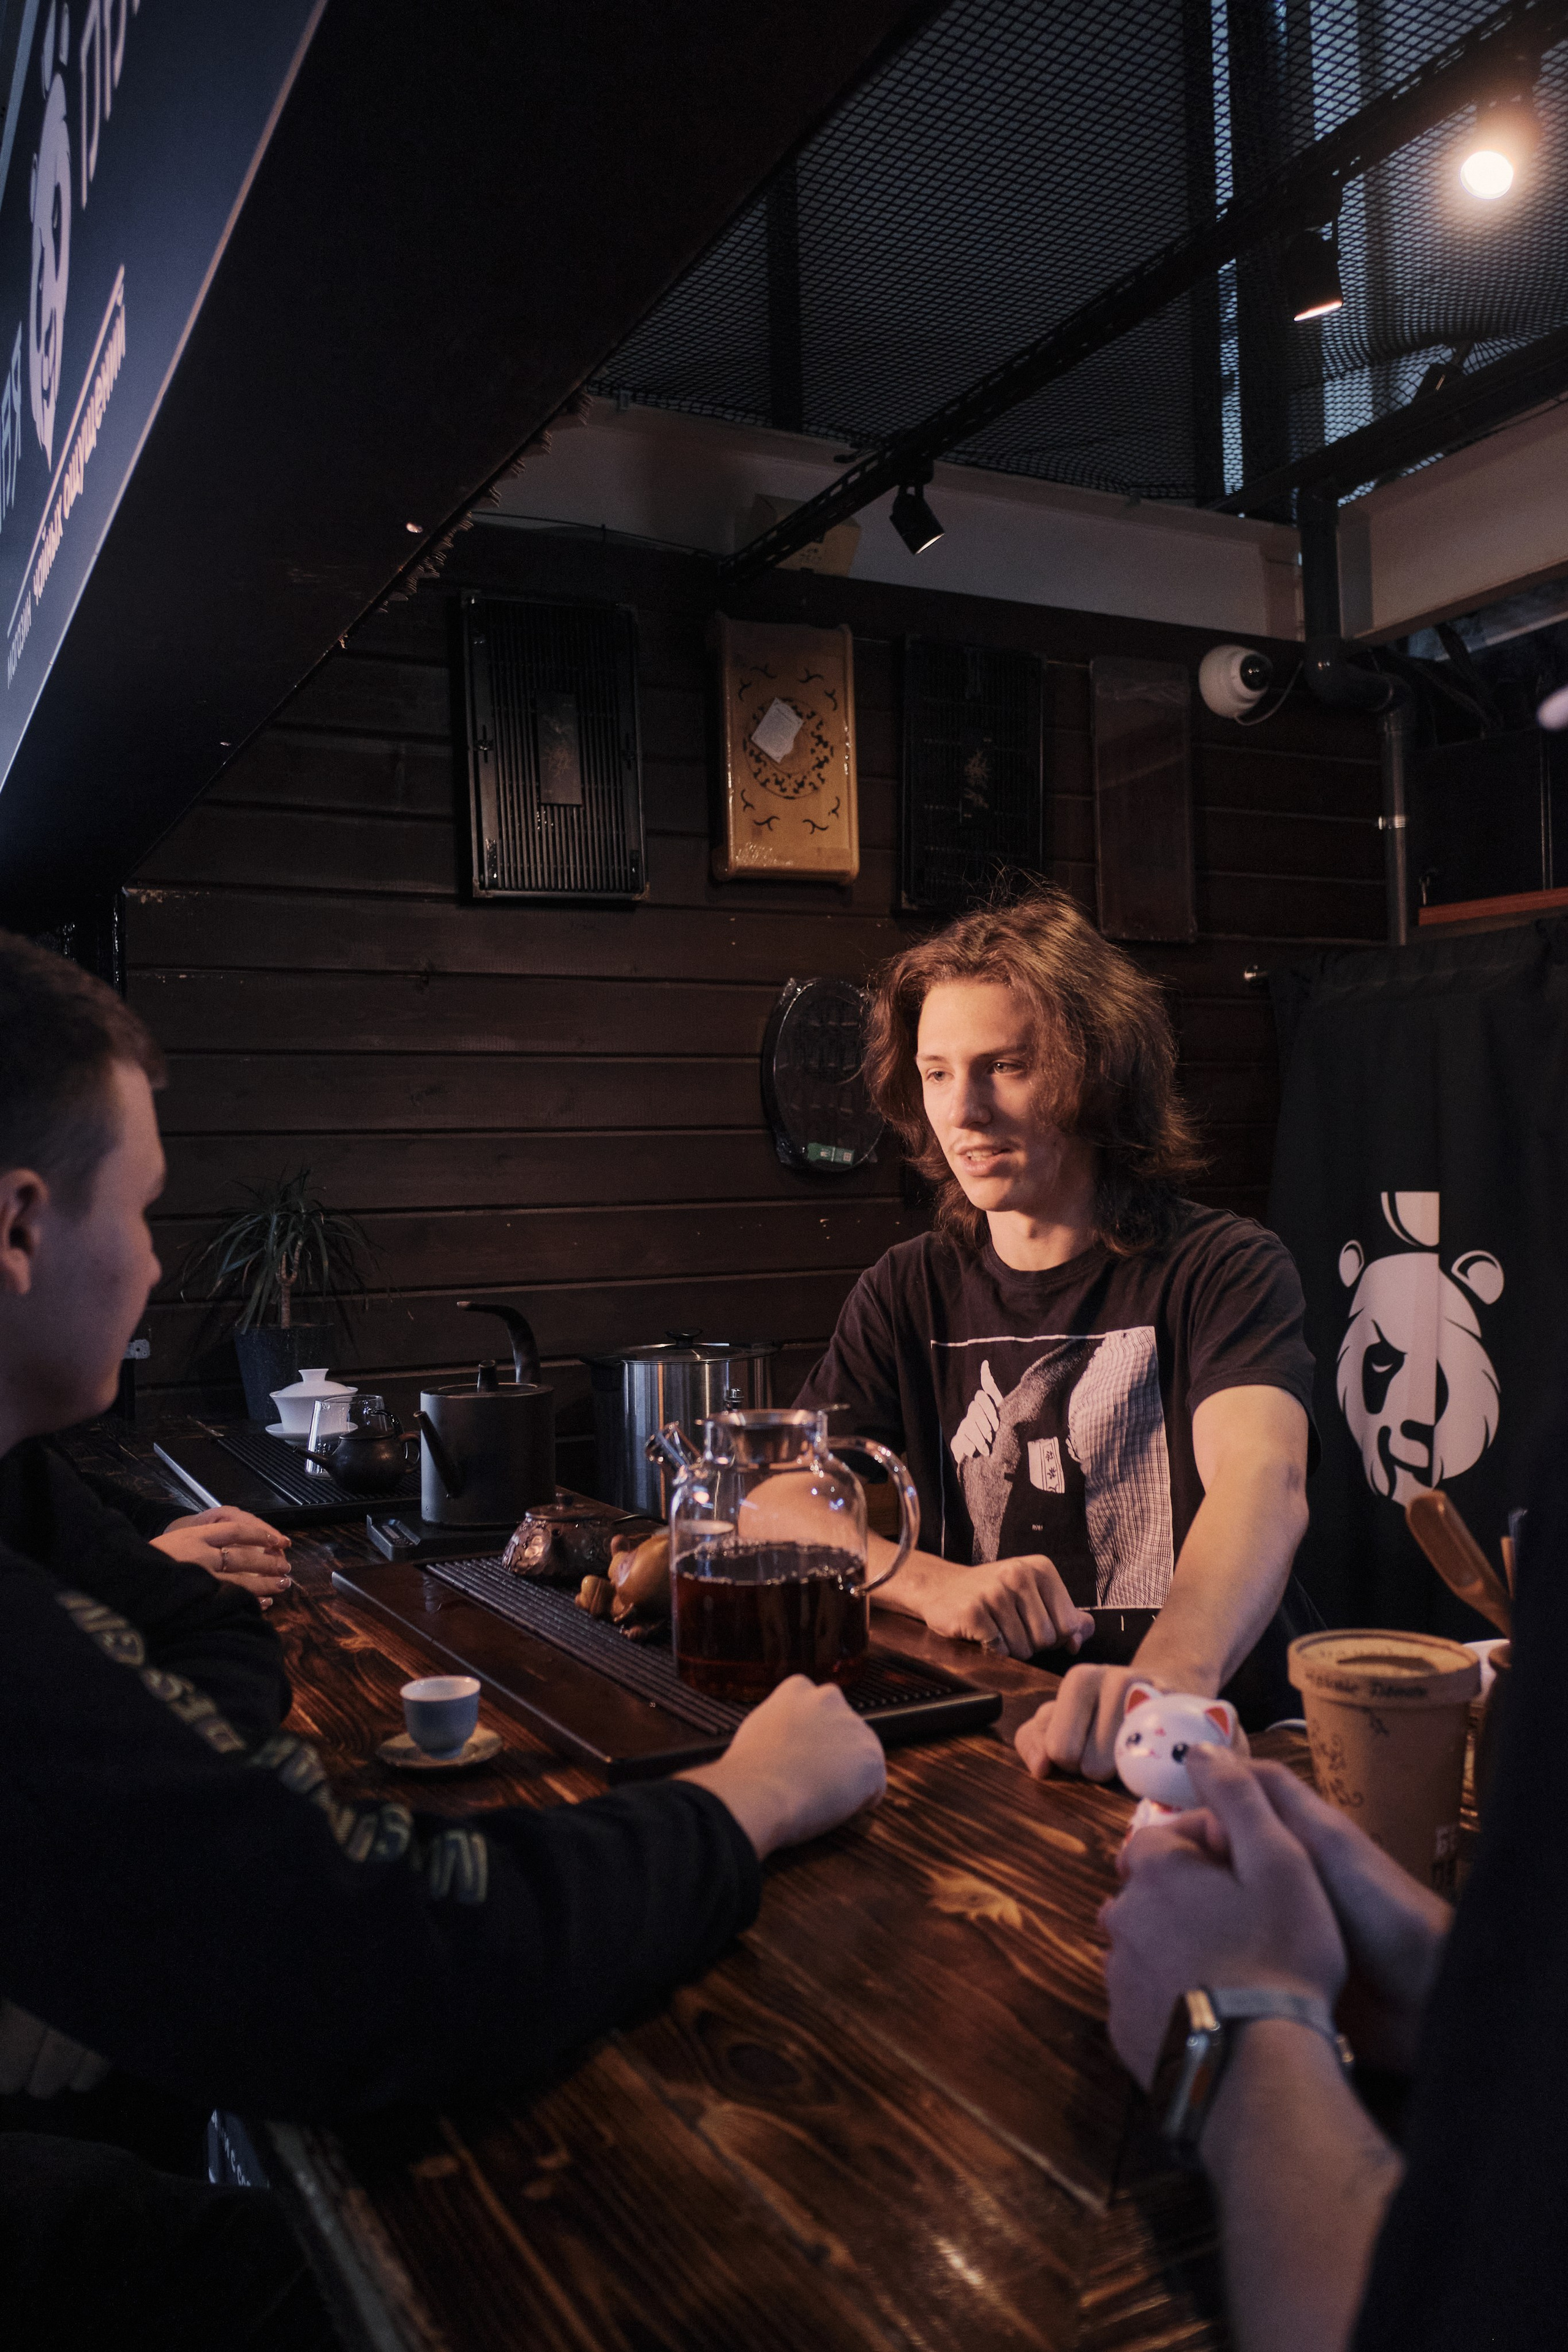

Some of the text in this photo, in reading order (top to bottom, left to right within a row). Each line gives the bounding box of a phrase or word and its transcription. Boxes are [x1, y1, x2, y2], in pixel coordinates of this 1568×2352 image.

[7, 284, 126, 690] магазин чайных ощущений
